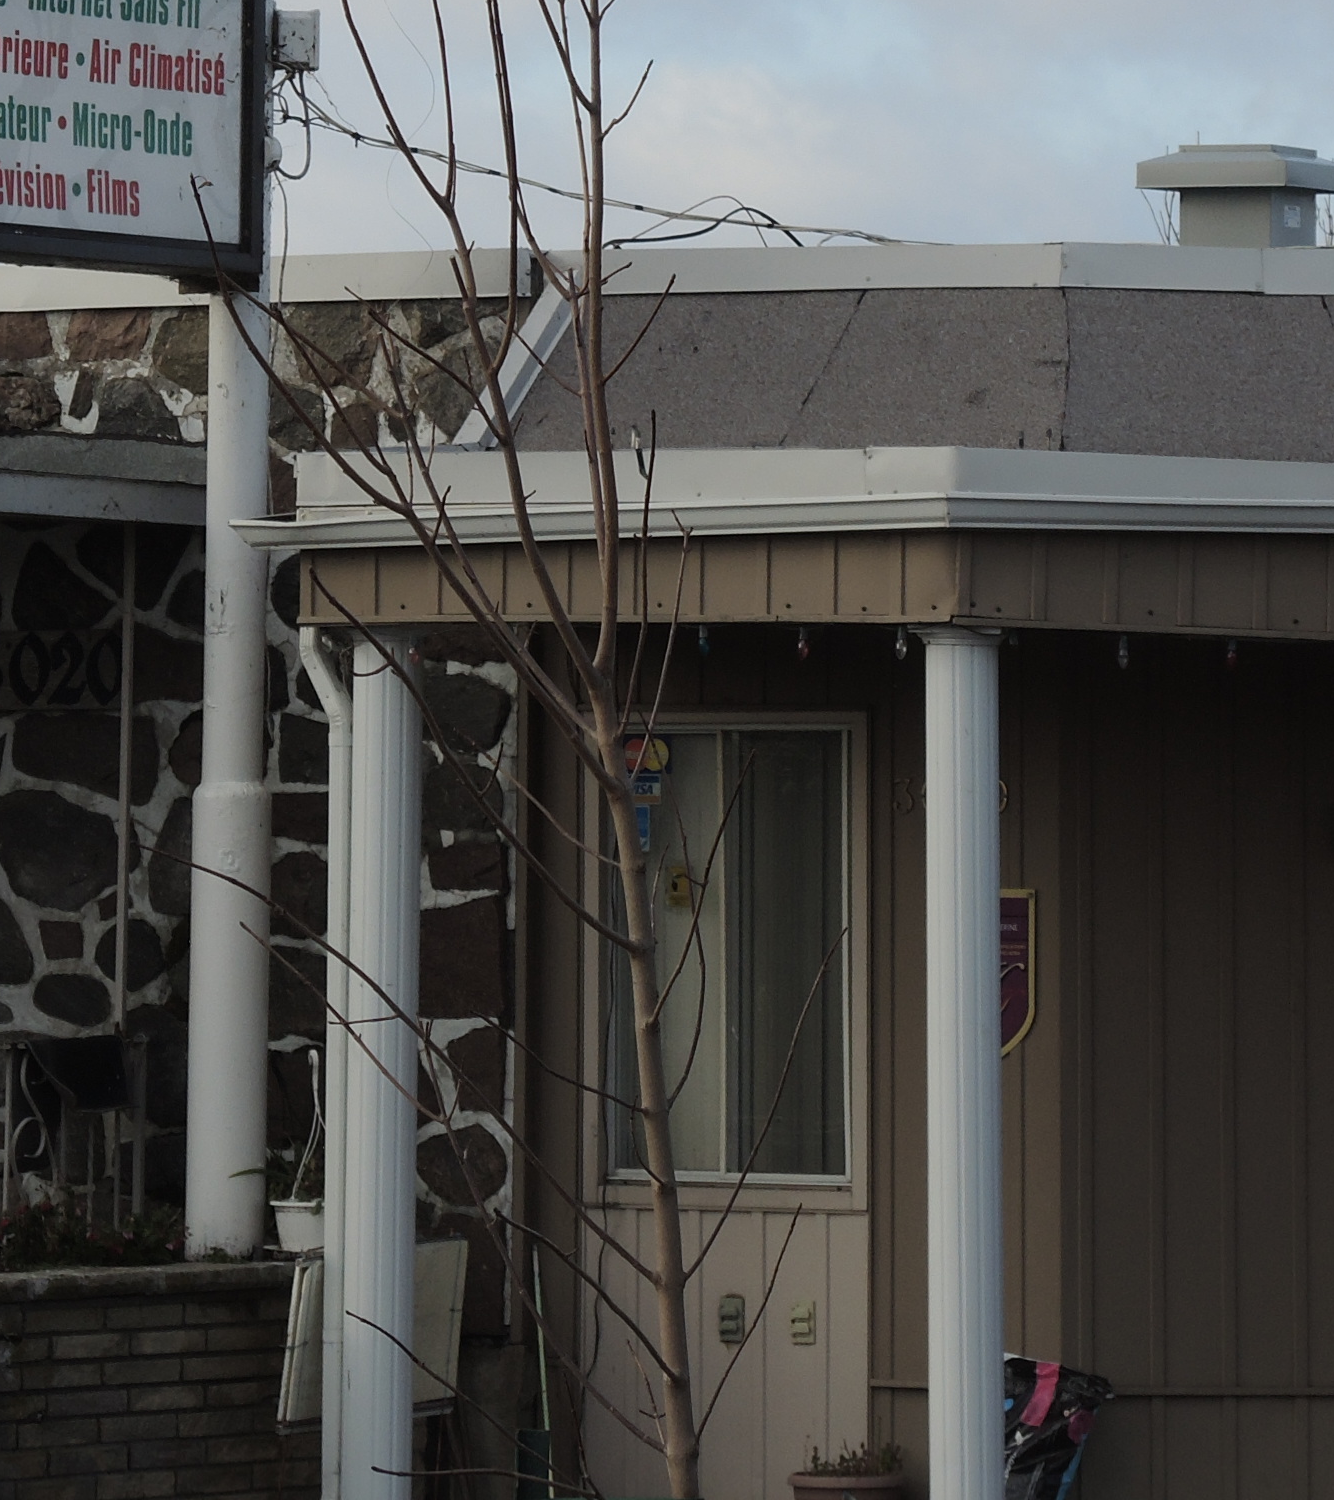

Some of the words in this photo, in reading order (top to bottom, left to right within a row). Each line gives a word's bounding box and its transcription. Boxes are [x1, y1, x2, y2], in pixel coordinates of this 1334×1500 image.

[89, 38, 122, 86] Air
[128, 42, 226, 96] Climatisé
[72, 101, 193, 157] Micro-Onde
[86, 168, 141, 217] Films
